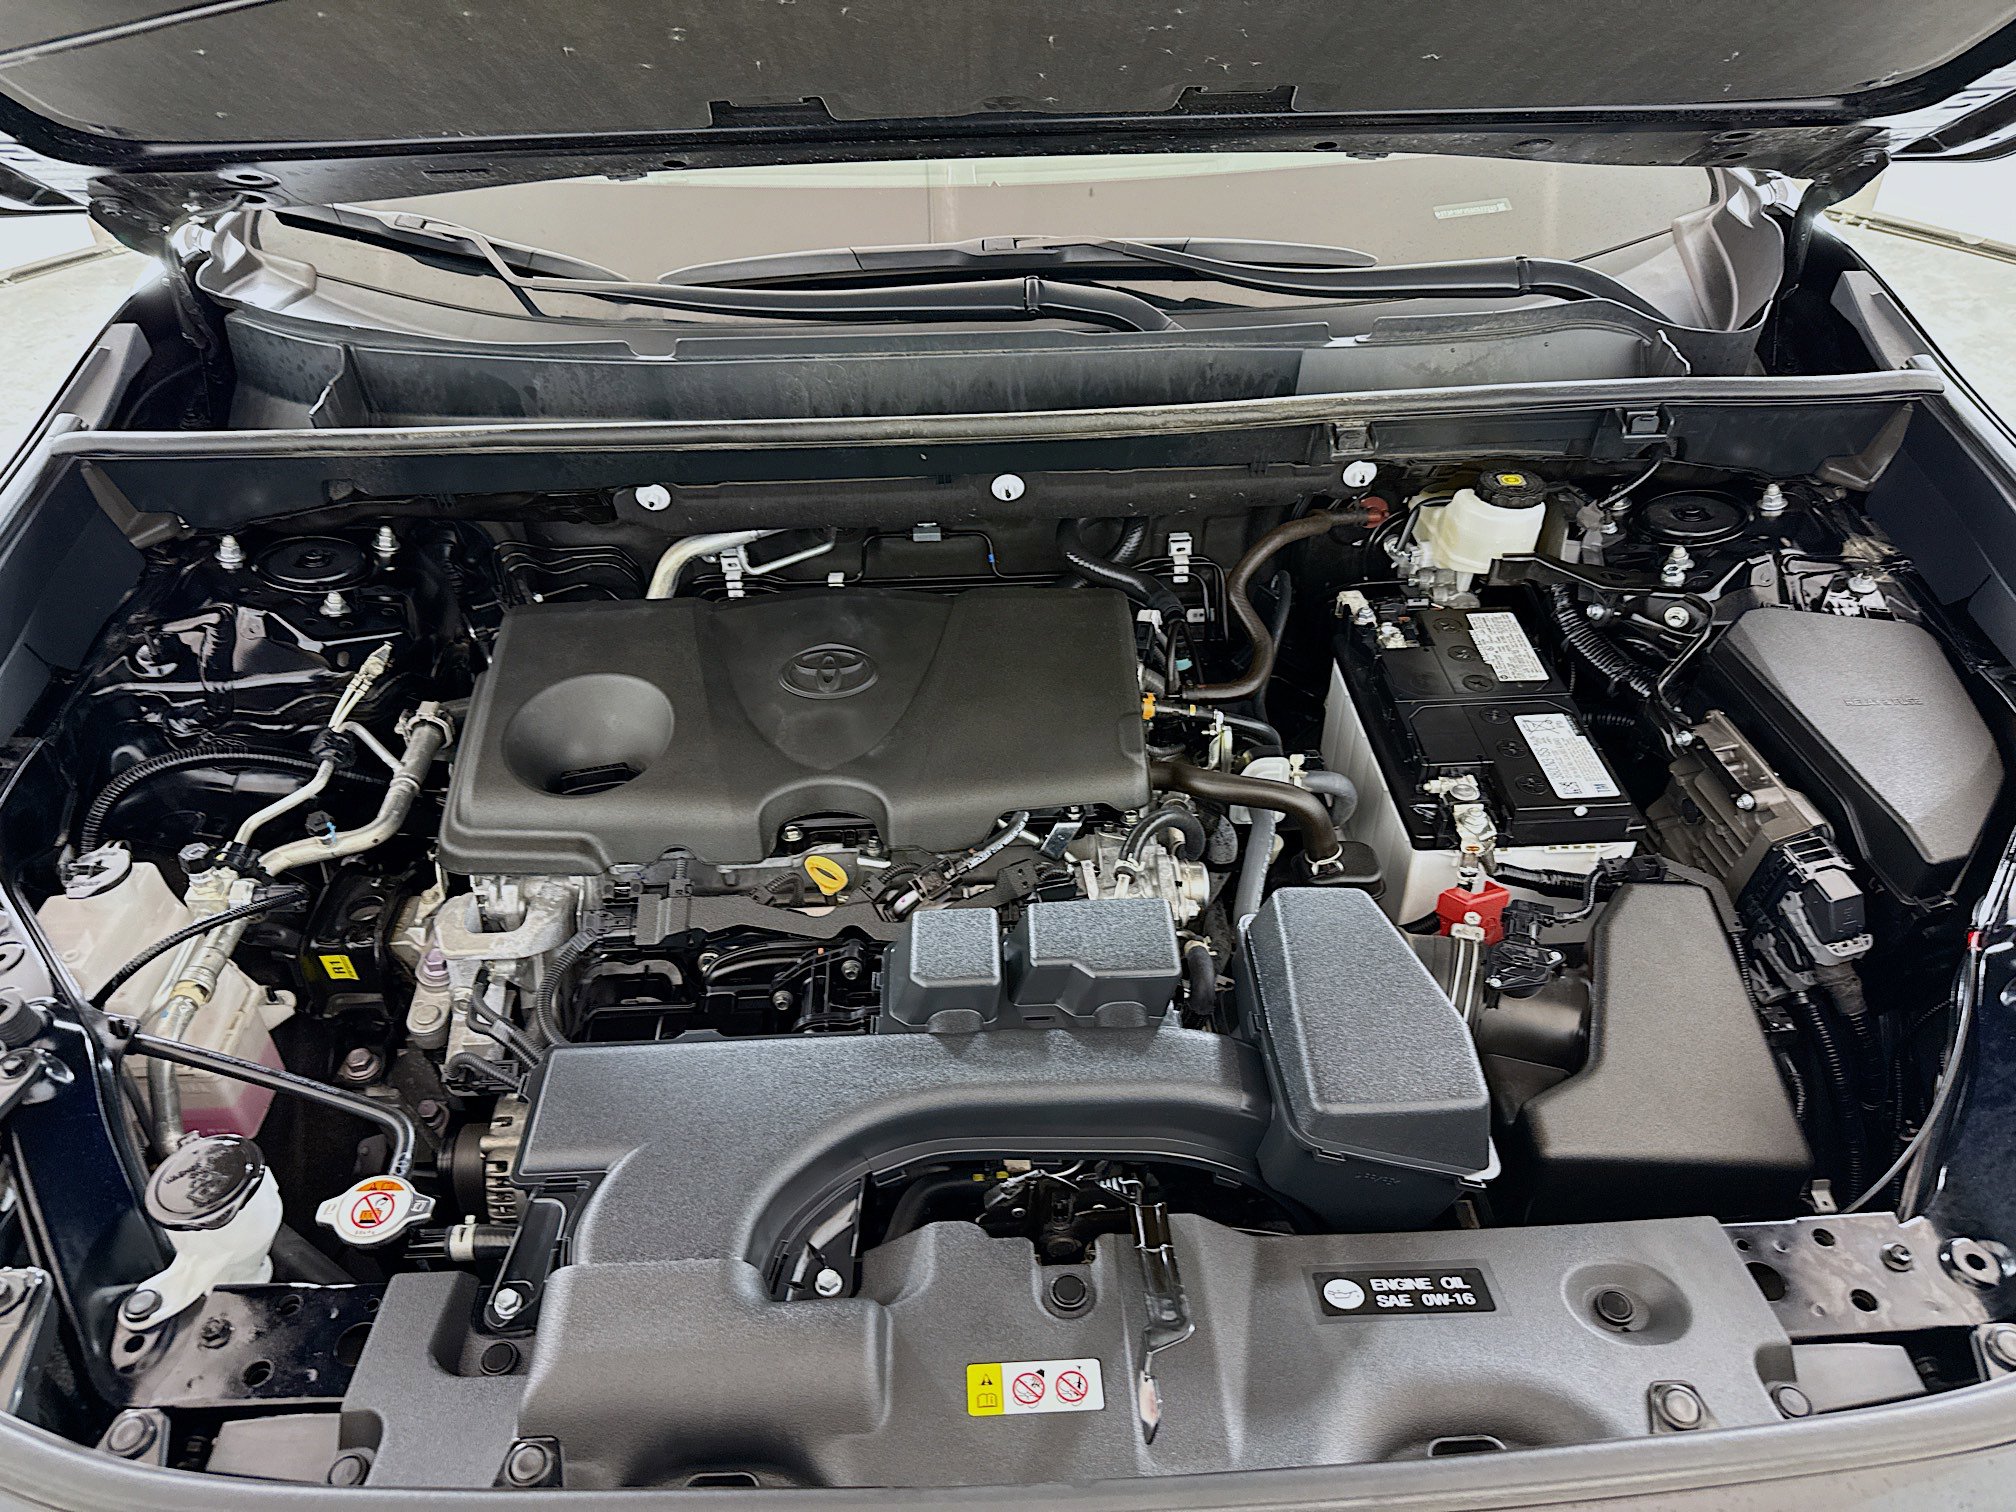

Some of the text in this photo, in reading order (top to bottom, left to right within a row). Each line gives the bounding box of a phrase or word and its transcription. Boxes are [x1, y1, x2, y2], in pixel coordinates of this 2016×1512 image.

[1369, 1276, 1471, 1291] ENGINE OIL
[1375, 1292, 1477, 1308] SAE 0W-16
